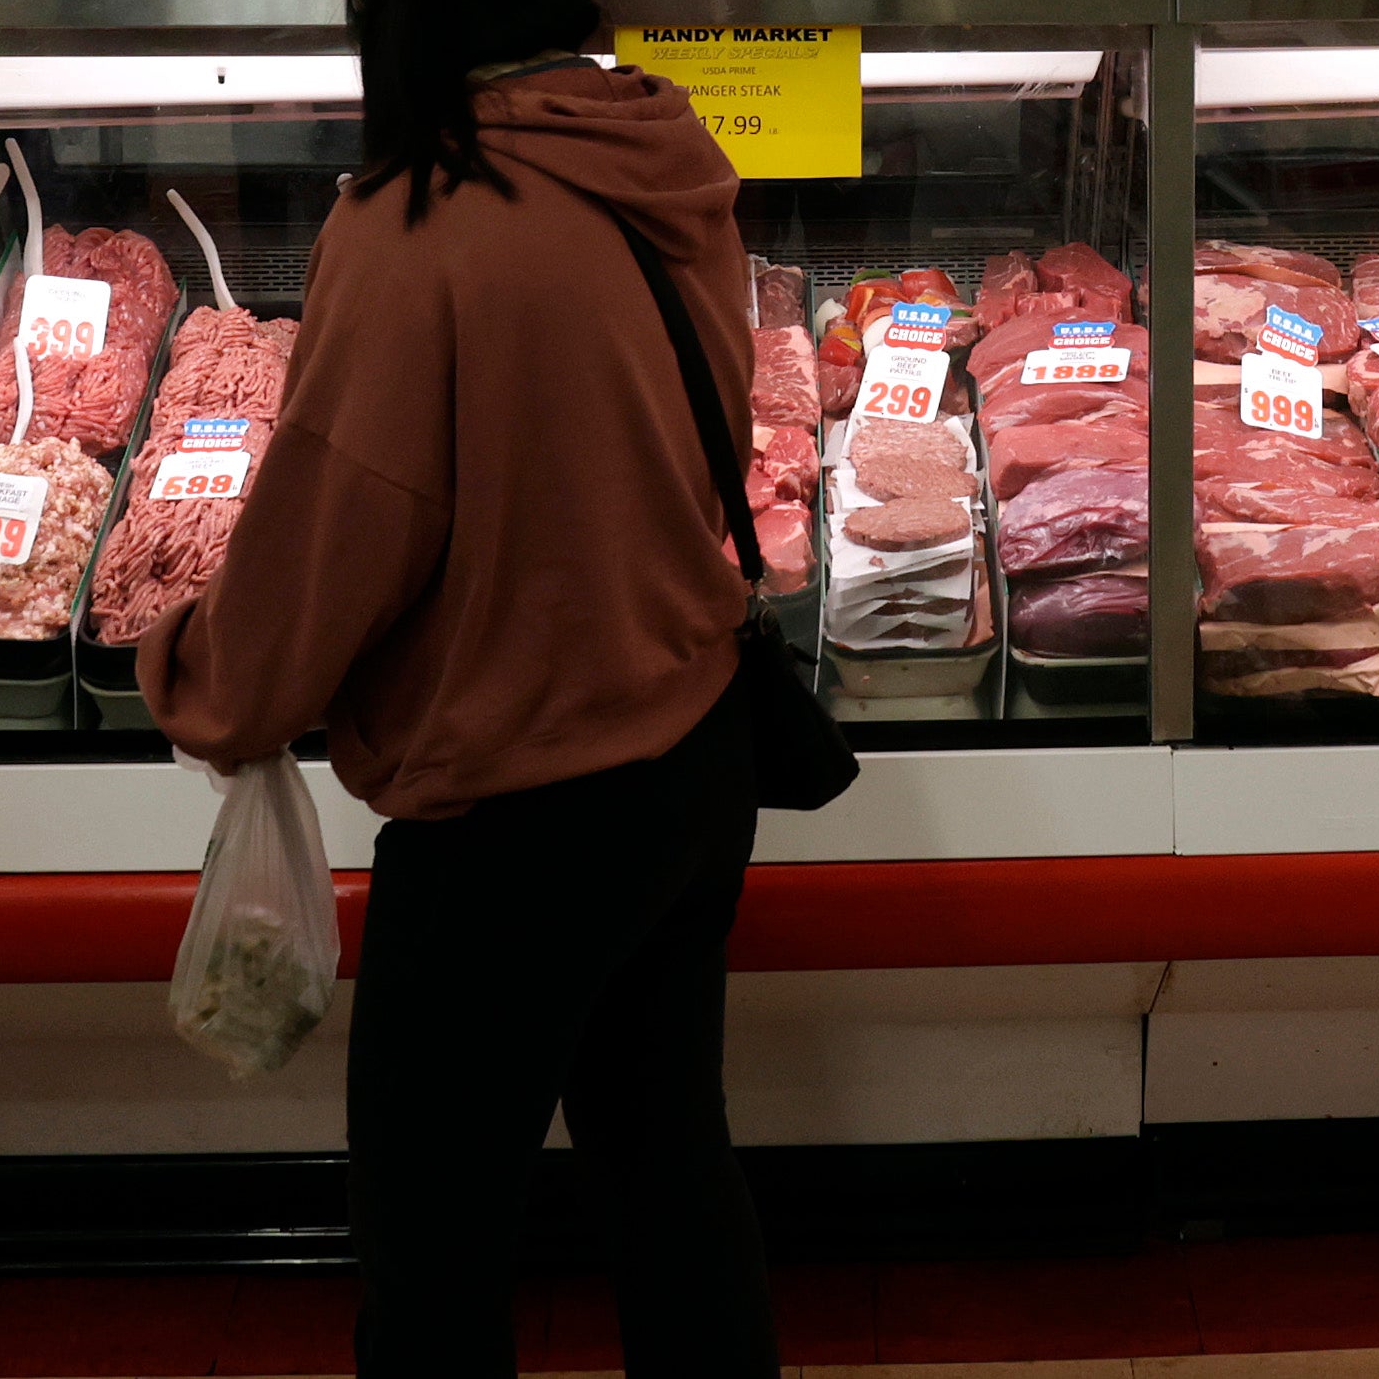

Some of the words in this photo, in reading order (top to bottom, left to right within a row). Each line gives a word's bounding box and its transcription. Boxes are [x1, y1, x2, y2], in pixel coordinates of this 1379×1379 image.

[643, 28, 725, 43] HANDY
[732, 27, 833, 42] MARKET
[651, 46, 725, 60] WEEKLY
[702, 67, 726, 75] USDA
[728, 66, 756, 75] PRIME
[739, 85, 781, 96] STEAK
[898, 309, 942, 324] U.S.D.A.
[1272, 313, 1315, 341] U.S.D.A.
[29, 317, 95, 358] 399
[888, 327, 943, 344] CHOICE
[1053, 337, 1111, 346] CHOICE
[1262, 328, 1316, 361] CHOICE
[891, 355, 927, 364] GROUND
[889, 367, 922, 377] PATTIES
[864, 381, 932, 418] 299
[1251, 390, 1313, 432] 999
[182, 438, 243, 448] CHOICE
